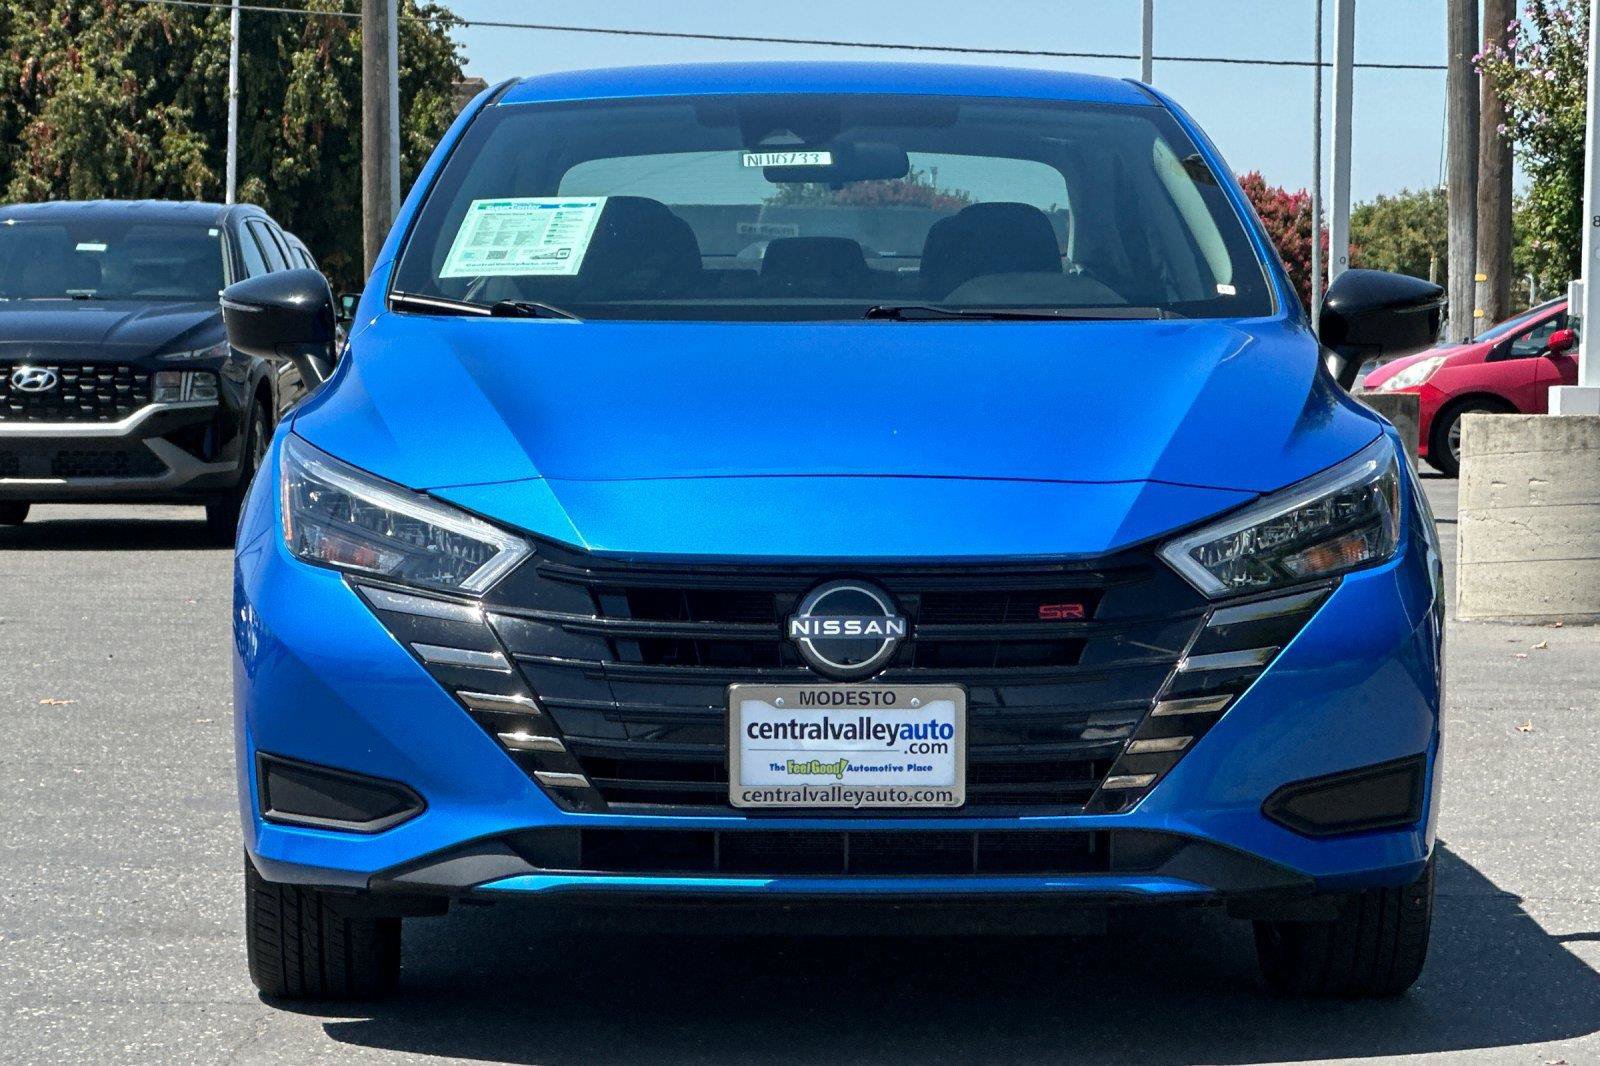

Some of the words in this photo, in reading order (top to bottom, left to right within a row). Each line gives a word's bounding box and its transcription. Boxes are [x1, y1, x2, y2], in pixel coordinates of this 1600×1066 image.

[1039, 604, 1083, 619] SR
[791, 620, 903, 635] NISSAN
[800, 691, 896, 706] MODESTO
[747, 716, 954, 746] centralvalleyauto
[904, 742, 948, 755] .com
[769, 763, 785, 772] The
[847, 763, 904, 773] Automotive
[907, 763, 933, 772] Place
[742, 786, 953, 806] centralvalleyauto.com
